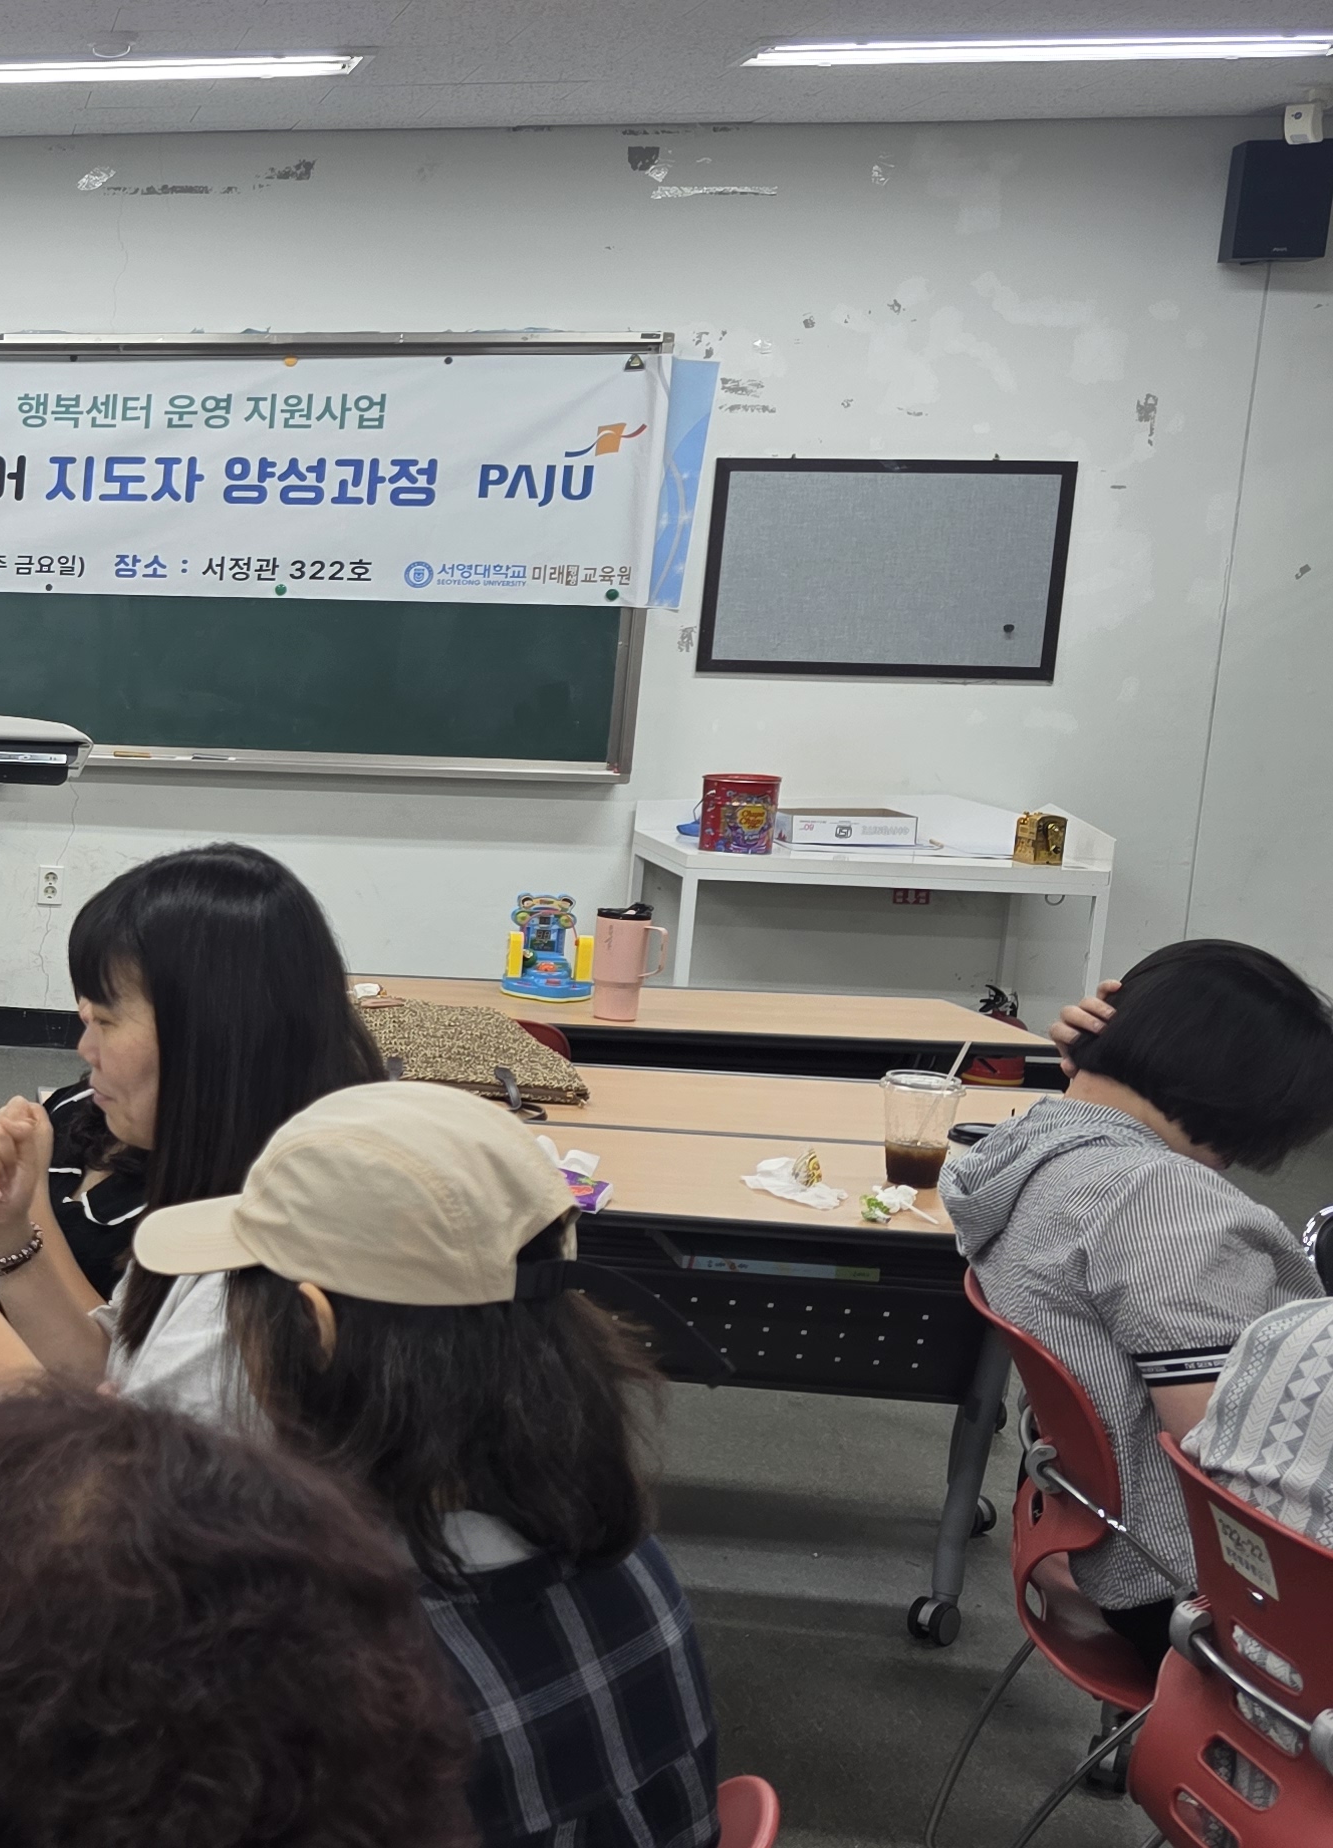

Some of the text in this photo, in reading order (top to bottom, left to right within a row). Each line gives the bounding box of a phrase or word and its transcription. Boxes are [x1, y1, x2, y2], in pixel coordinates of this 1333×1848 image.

[18, 393, 152, 429] 행복센터
[164, 394, 232, 428] 운영
[244, 394, 387, 430] 지원사업
[46, 456, 204, 503] 지도자
[223, 457, 438, 507] 양성과정
[478, 463, 594, 507] PAJU
[15, 555, 85, 577] 금요일)
[115, 555, 167, 579] 장소
[202, 556, 279, 582] 서정관
[289, 559, 372, 582] 322호
[437, 563, 527, 579] 서영대학교
[483, 579, 527, 587] UNIVERSITY
